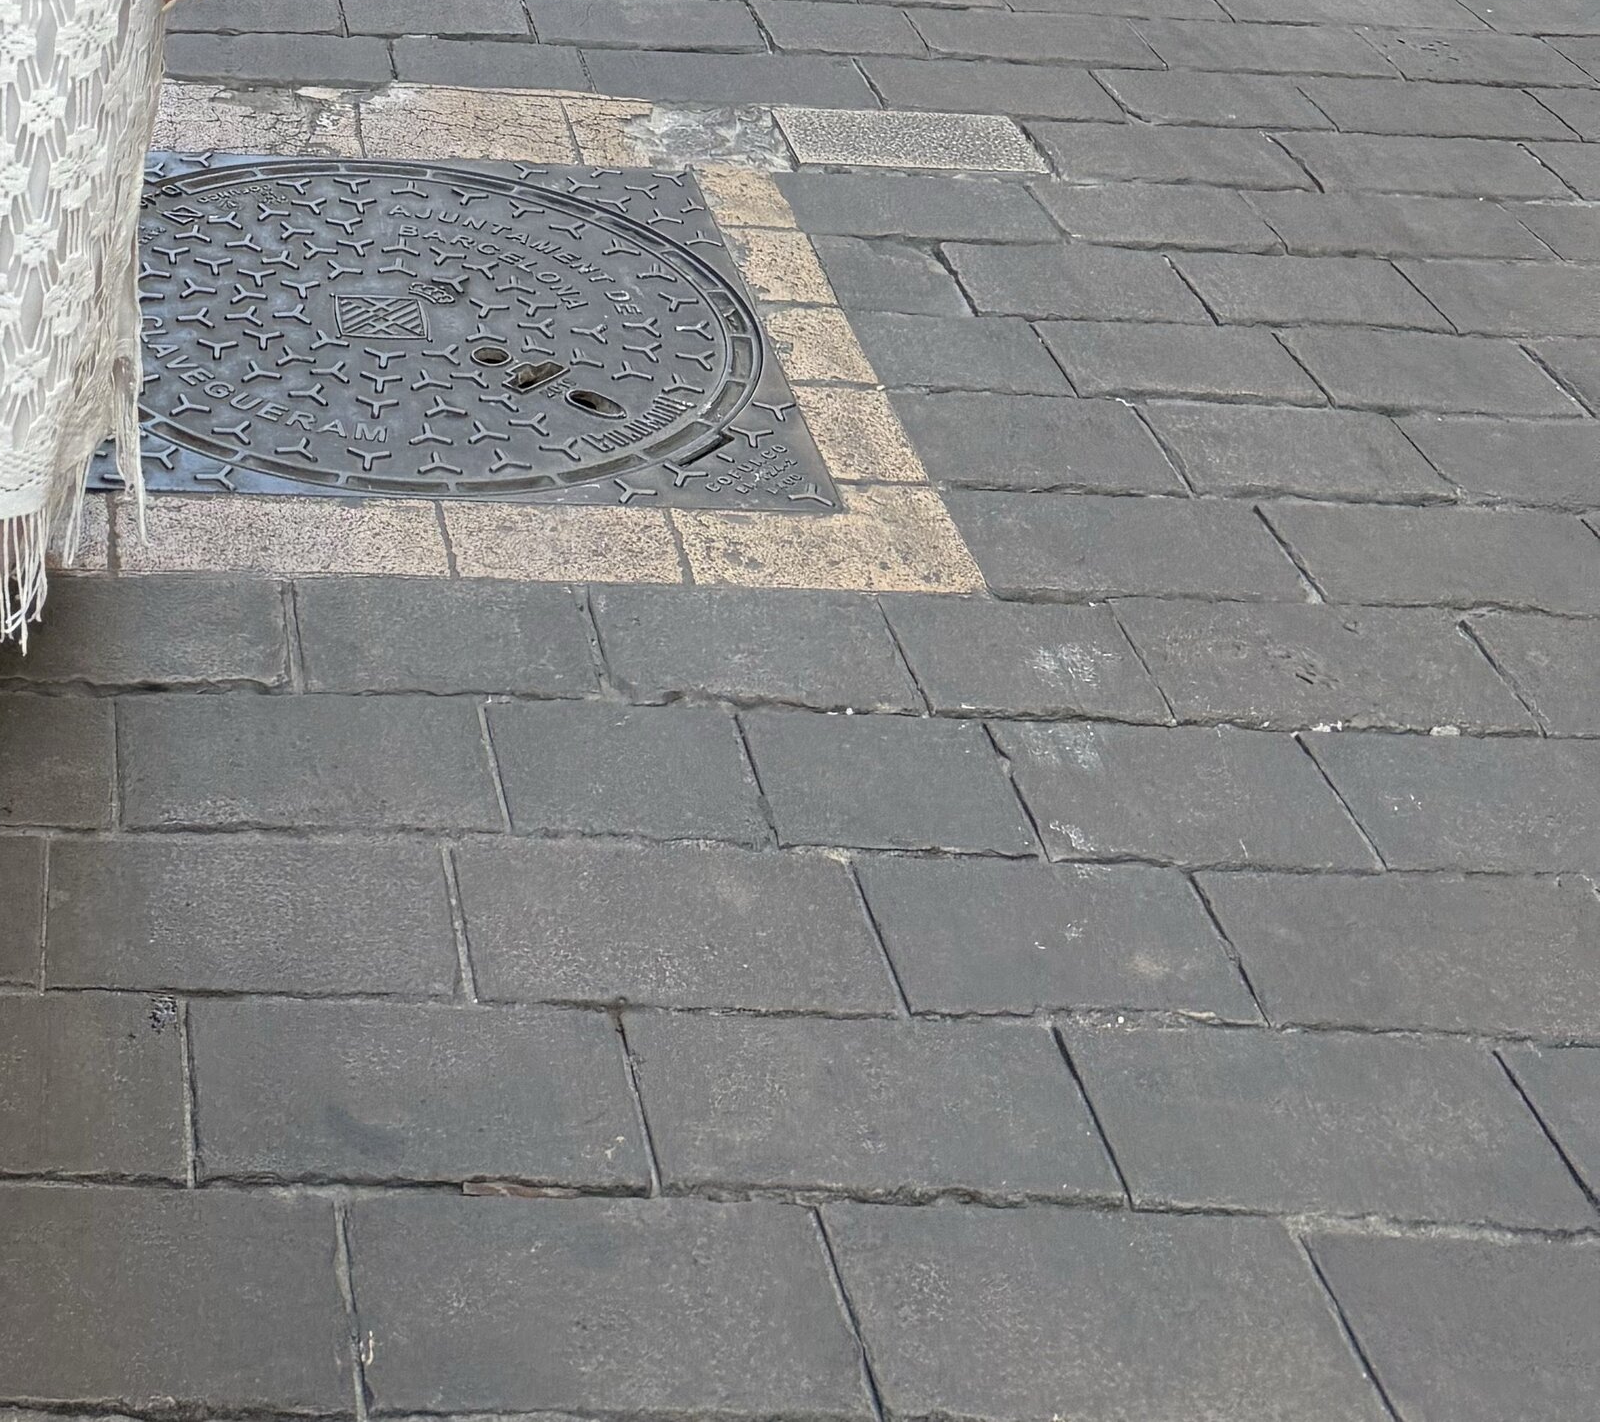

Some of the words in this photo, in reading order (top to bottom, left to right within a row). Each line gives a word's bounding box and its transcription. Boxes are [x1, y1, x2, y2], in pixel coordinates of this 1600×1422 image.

[388, 204, 615, 283] AJUNTAMENT
[604, 289, 643, 316] DE
[397, 223, 589, 311] BARCELONA
[141, 314, 389, 444] CLAVEGUERAM
